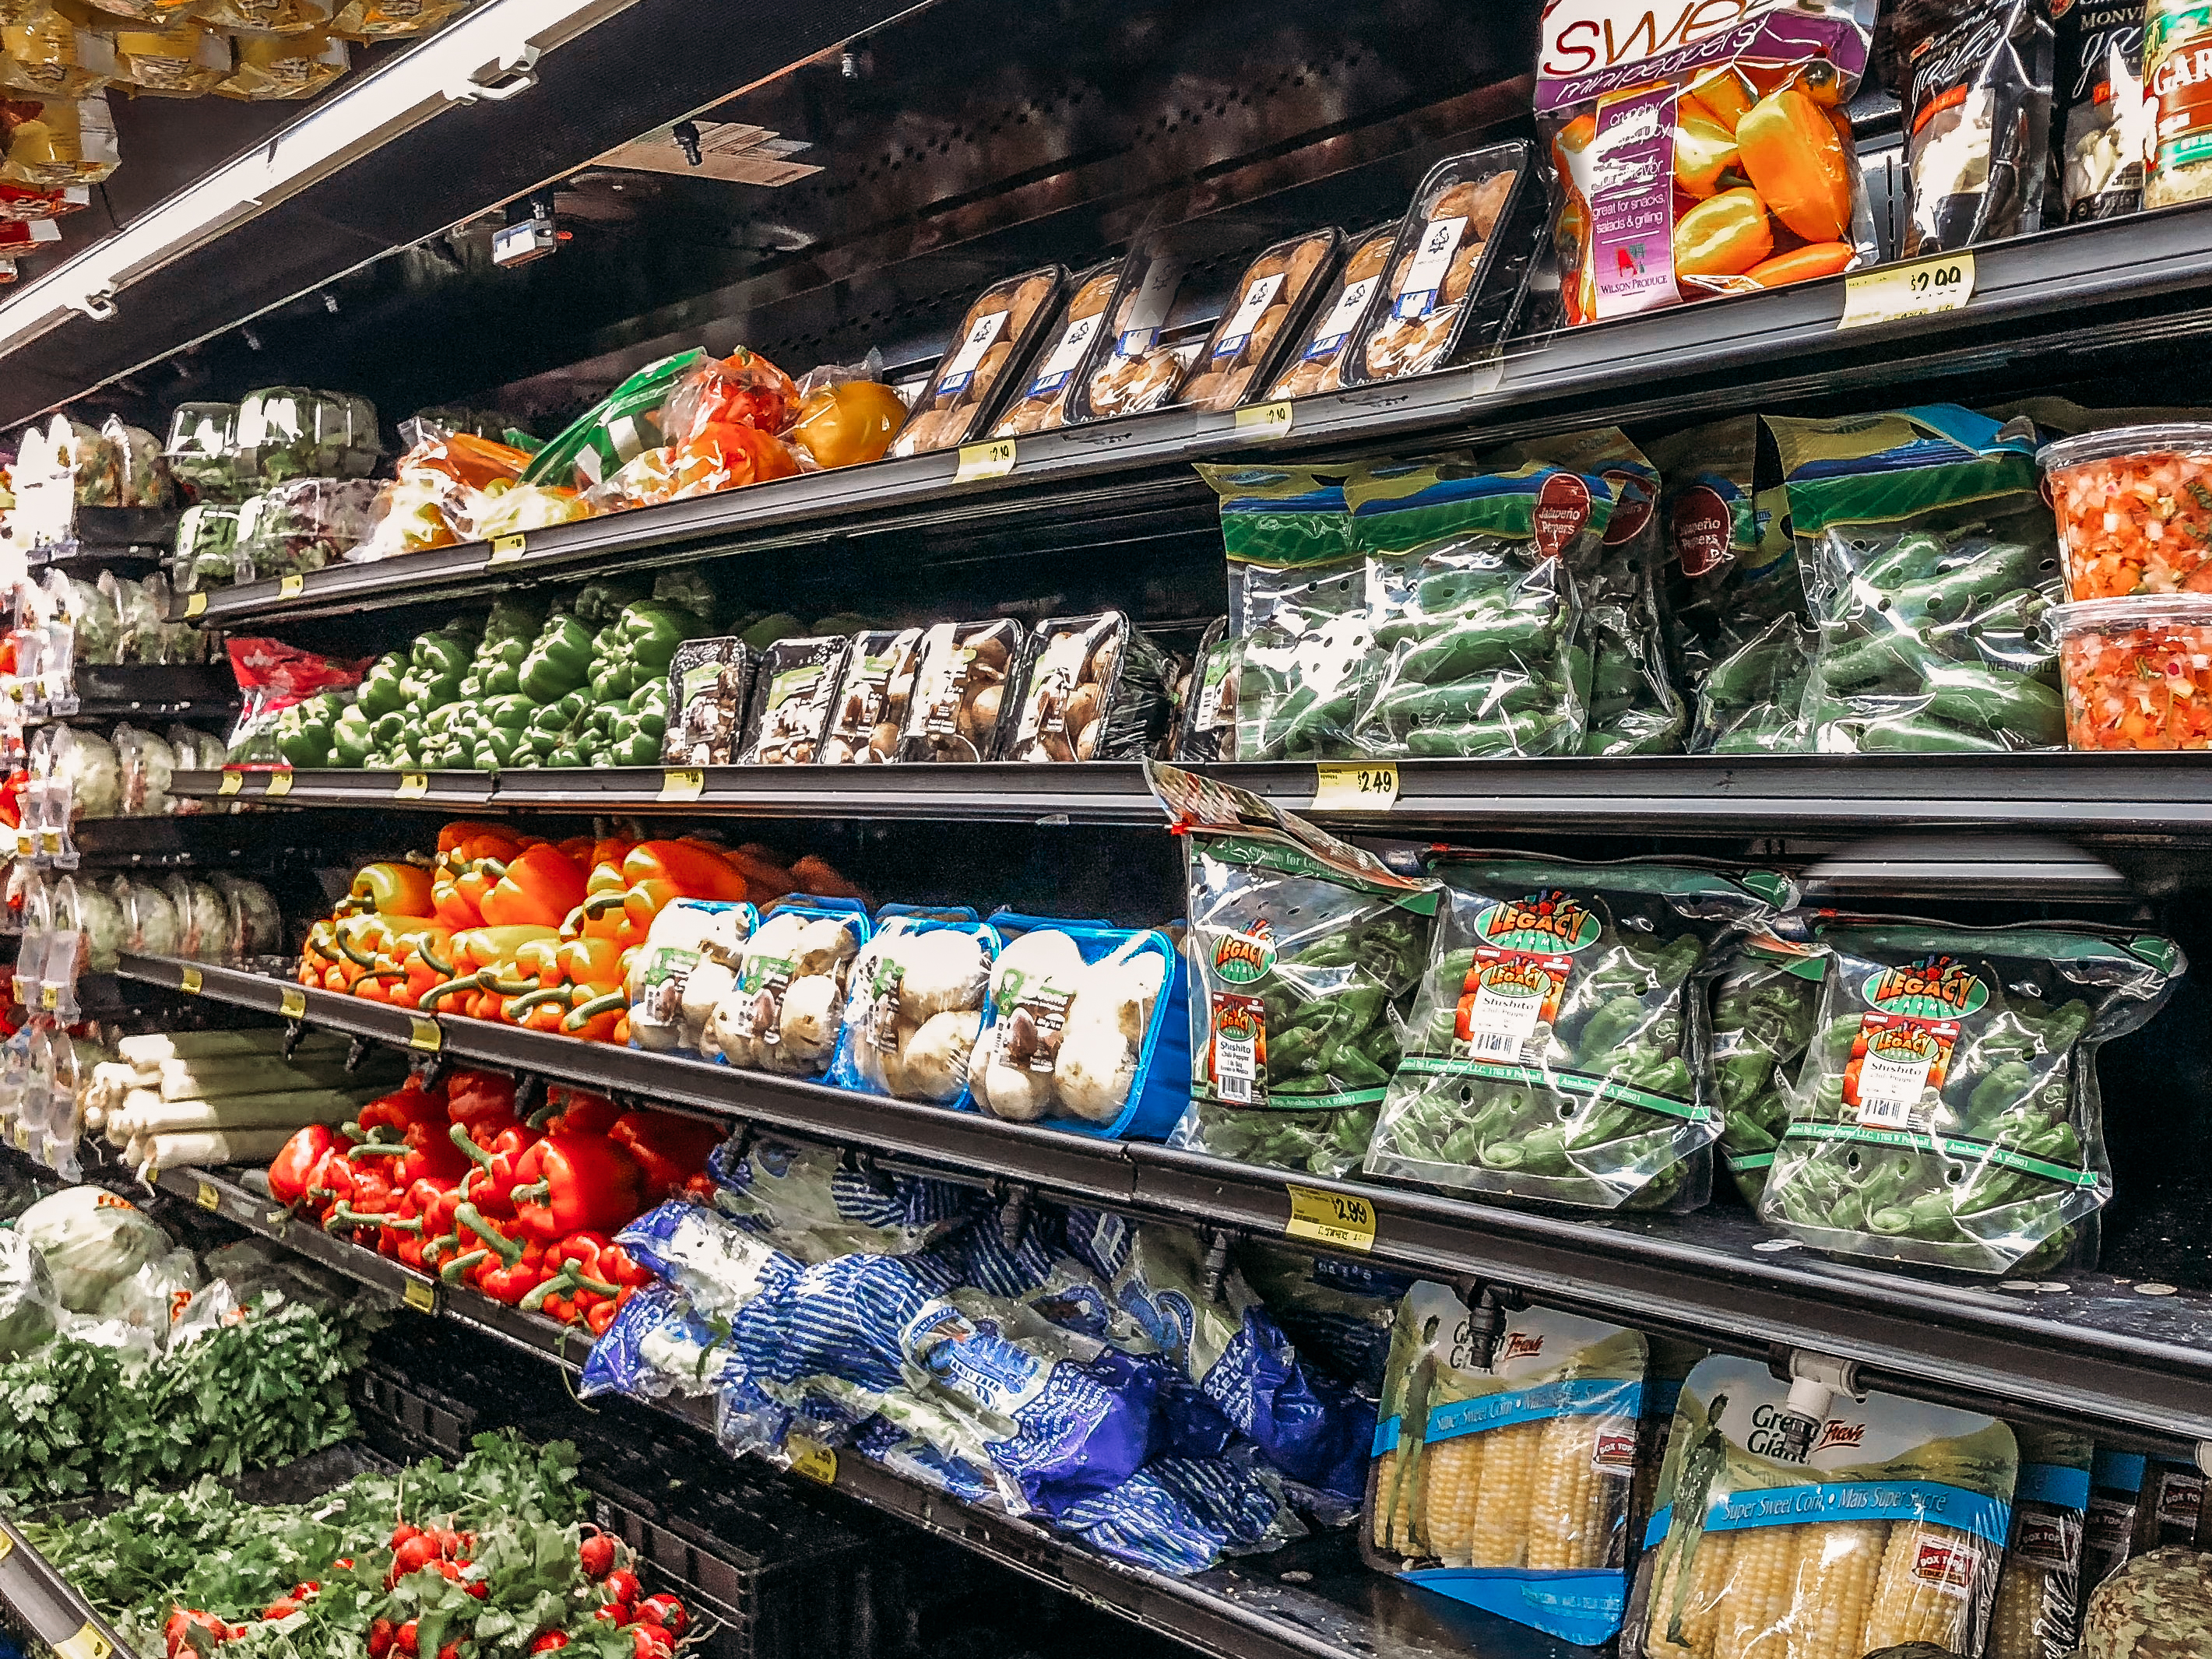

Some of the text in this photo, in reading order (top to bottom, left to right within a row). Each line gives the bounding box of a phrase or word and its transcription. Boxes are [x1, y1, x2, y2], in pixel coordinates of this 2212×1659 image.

[1592, 202, 1616, 221] great
[1618, 200, 1629, 212] for
[1596, 212, 1663, 234] salads & grilling
[1632, 274, 1668, 291] PRODUCE
[1357, 770, 1392, 793] $2.49
[1487, 901, 1590, 944] LEGACY
[1503, 933, 1563, 947] FARMS
[1216, 933, 1265, 972] LEGACY
[1487, 965, 1544, 991] LEGACY
[1875, 966, 1978, 1010] LEGACY
[1482, 997, 1535, 1011] Shishito
[1891, 999, 1950, 1013] FARMS
[1220, 1013, 1249, 1030] LEGACY
[1220, 1040, 1251, 1055] Shishito
[1875, 1030, 1932, 1056] LEGACY
[1869, 1062, 1922, 1077] Shishito
[1331, 1196, 1367, 1225] $2.99
[1820, 1419, 1866, 1449] Fresh
[1600, 1443, 1616, 1454] BOX
[1721, 1500, 1757, 1526] Super
[1758, 1496, 1792, 1518] Sweet
[1796, 1491, 1823, 1512] Corn
[1869, 1486, 1907, 1515] Super
[1920, 1555, 1940, 1567] BOX
